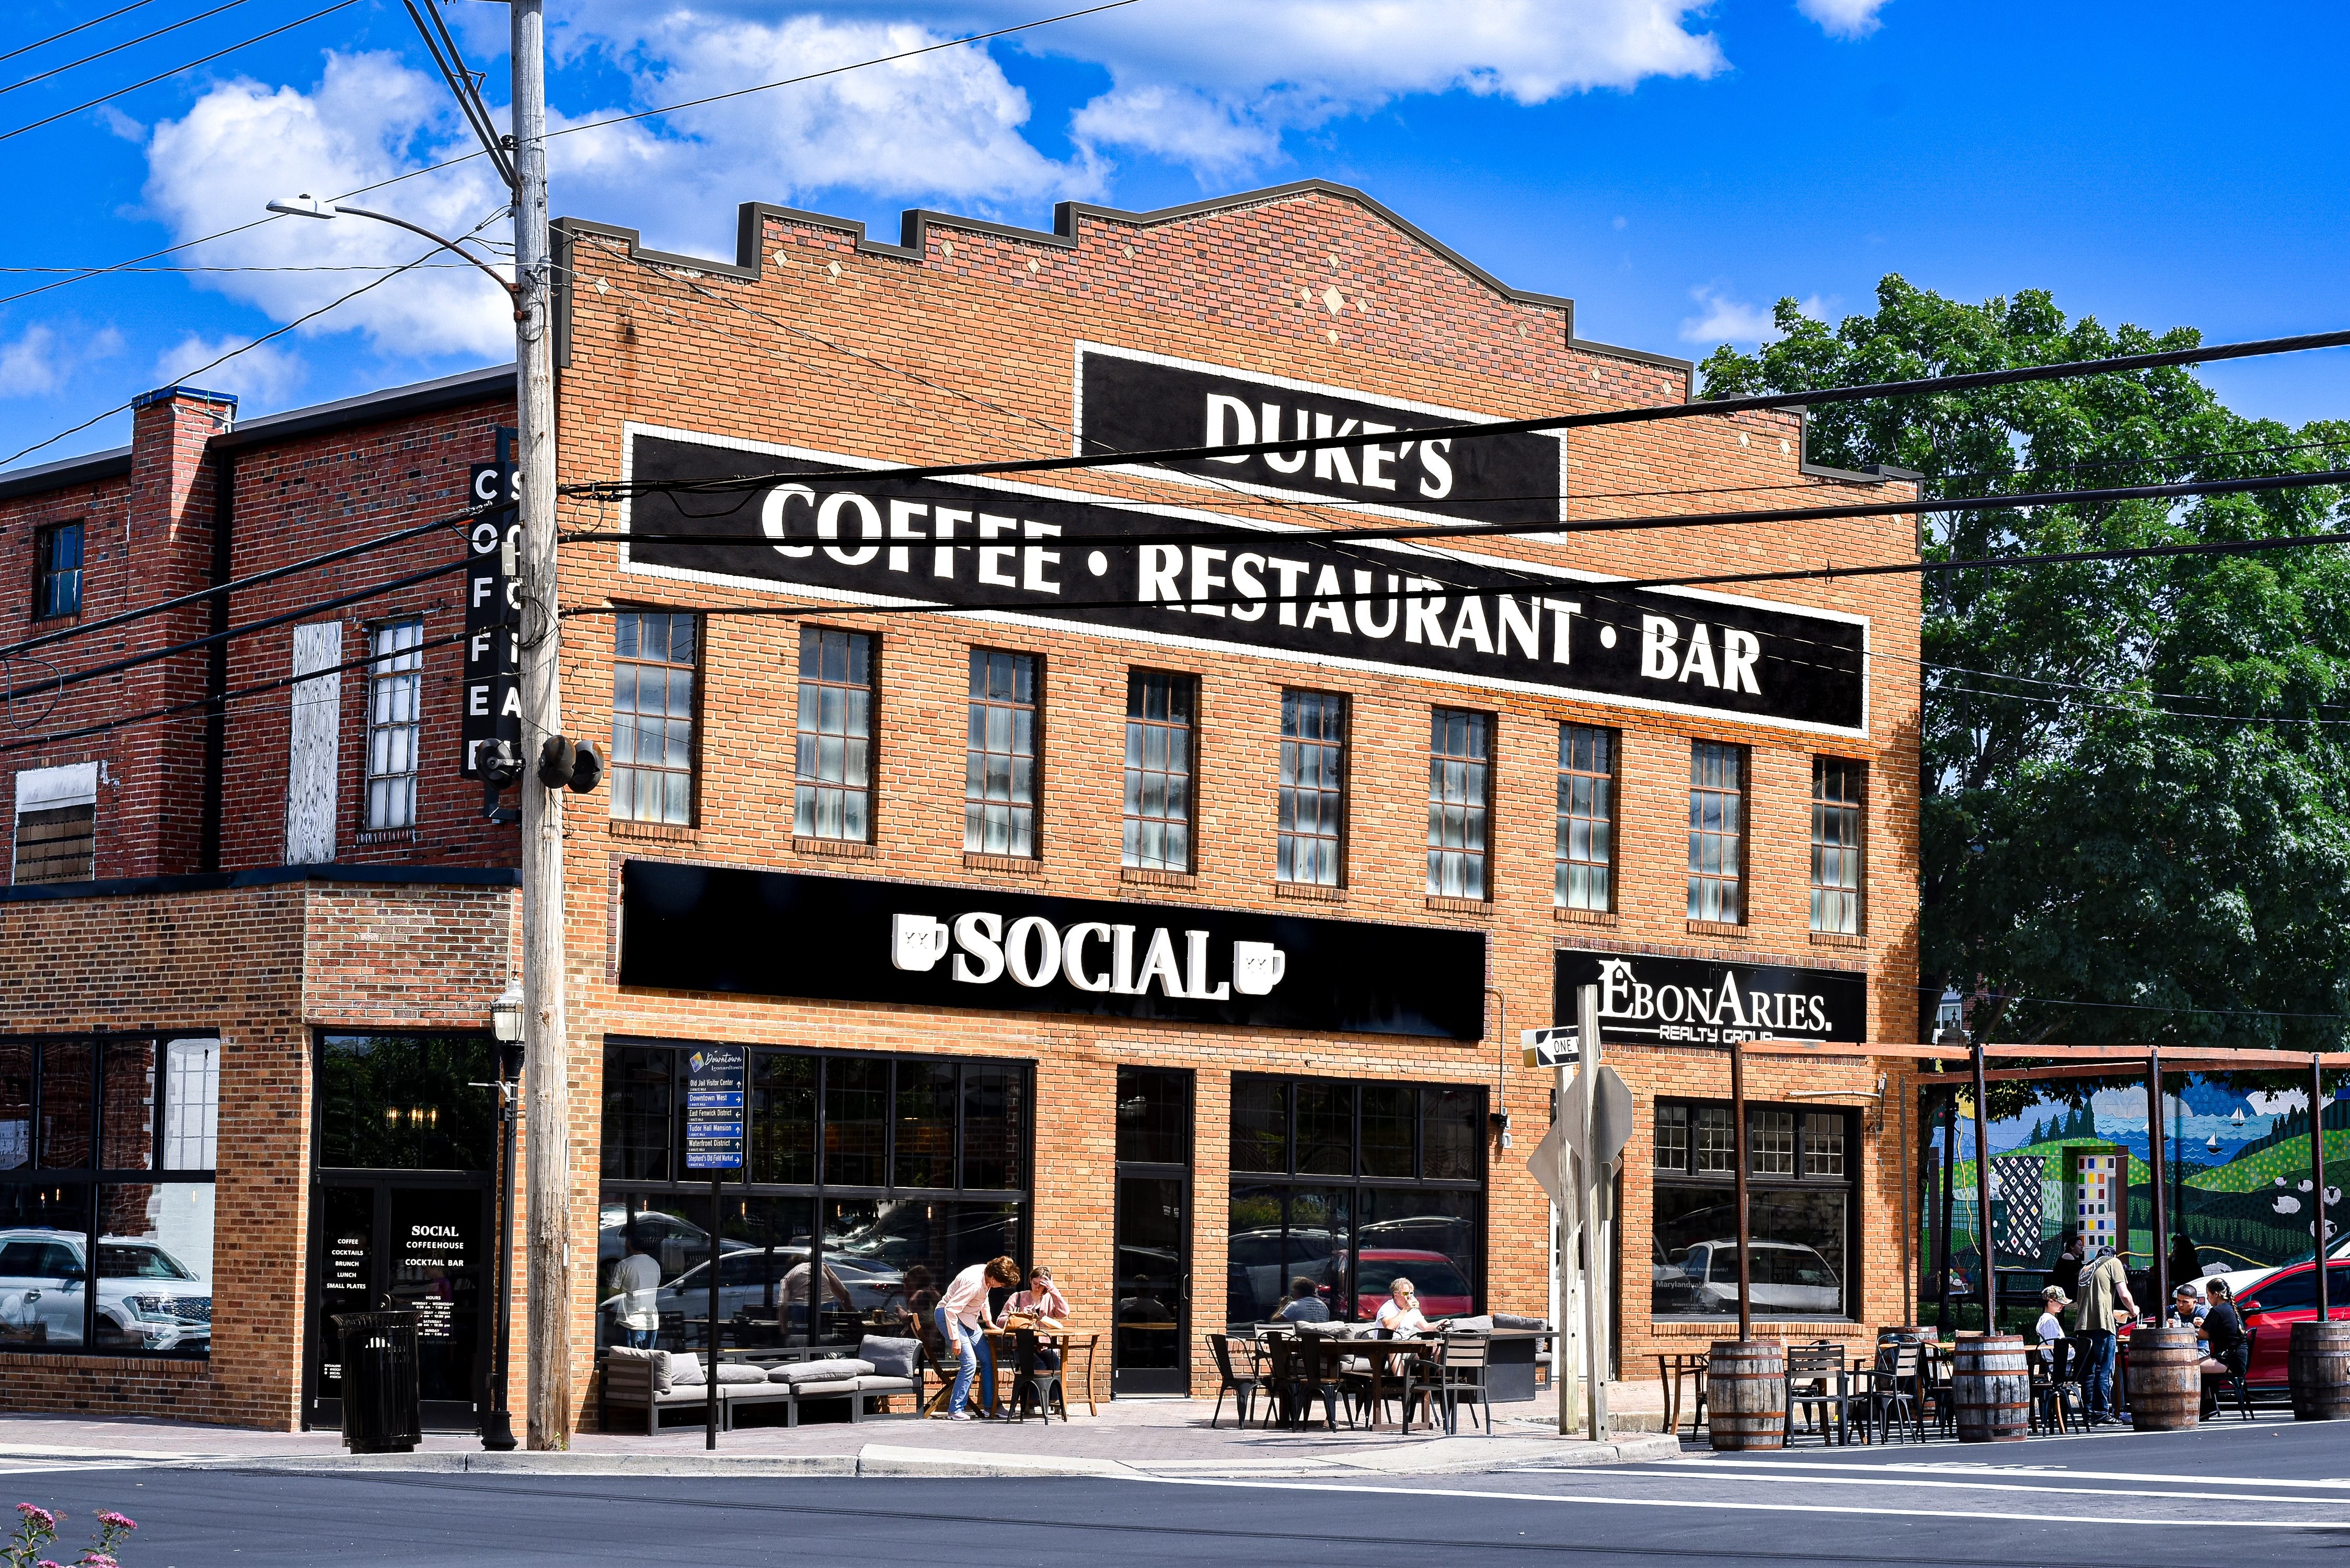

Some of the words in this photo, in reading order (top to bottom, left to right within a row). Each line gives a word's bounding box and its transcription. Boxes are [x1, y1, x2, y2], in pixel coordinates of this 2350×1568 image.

[1205, 393, 1454, 500] DUKE'S
[761, 483, 1063, 595] COFFEE
[1137, 544, 1582, 664] RESTAURANT
[1641, 614, 1762, 695] BAR
[952, 912, 1230, 1000] SOCIAL
[1659, 1025, 1718, 1043] REALTY
[1554, 1039, 1572, 1053] ONE
[705, 1052, 742, 1066] Downtown
[411, 1225, 459, 1237] SOCIAL
